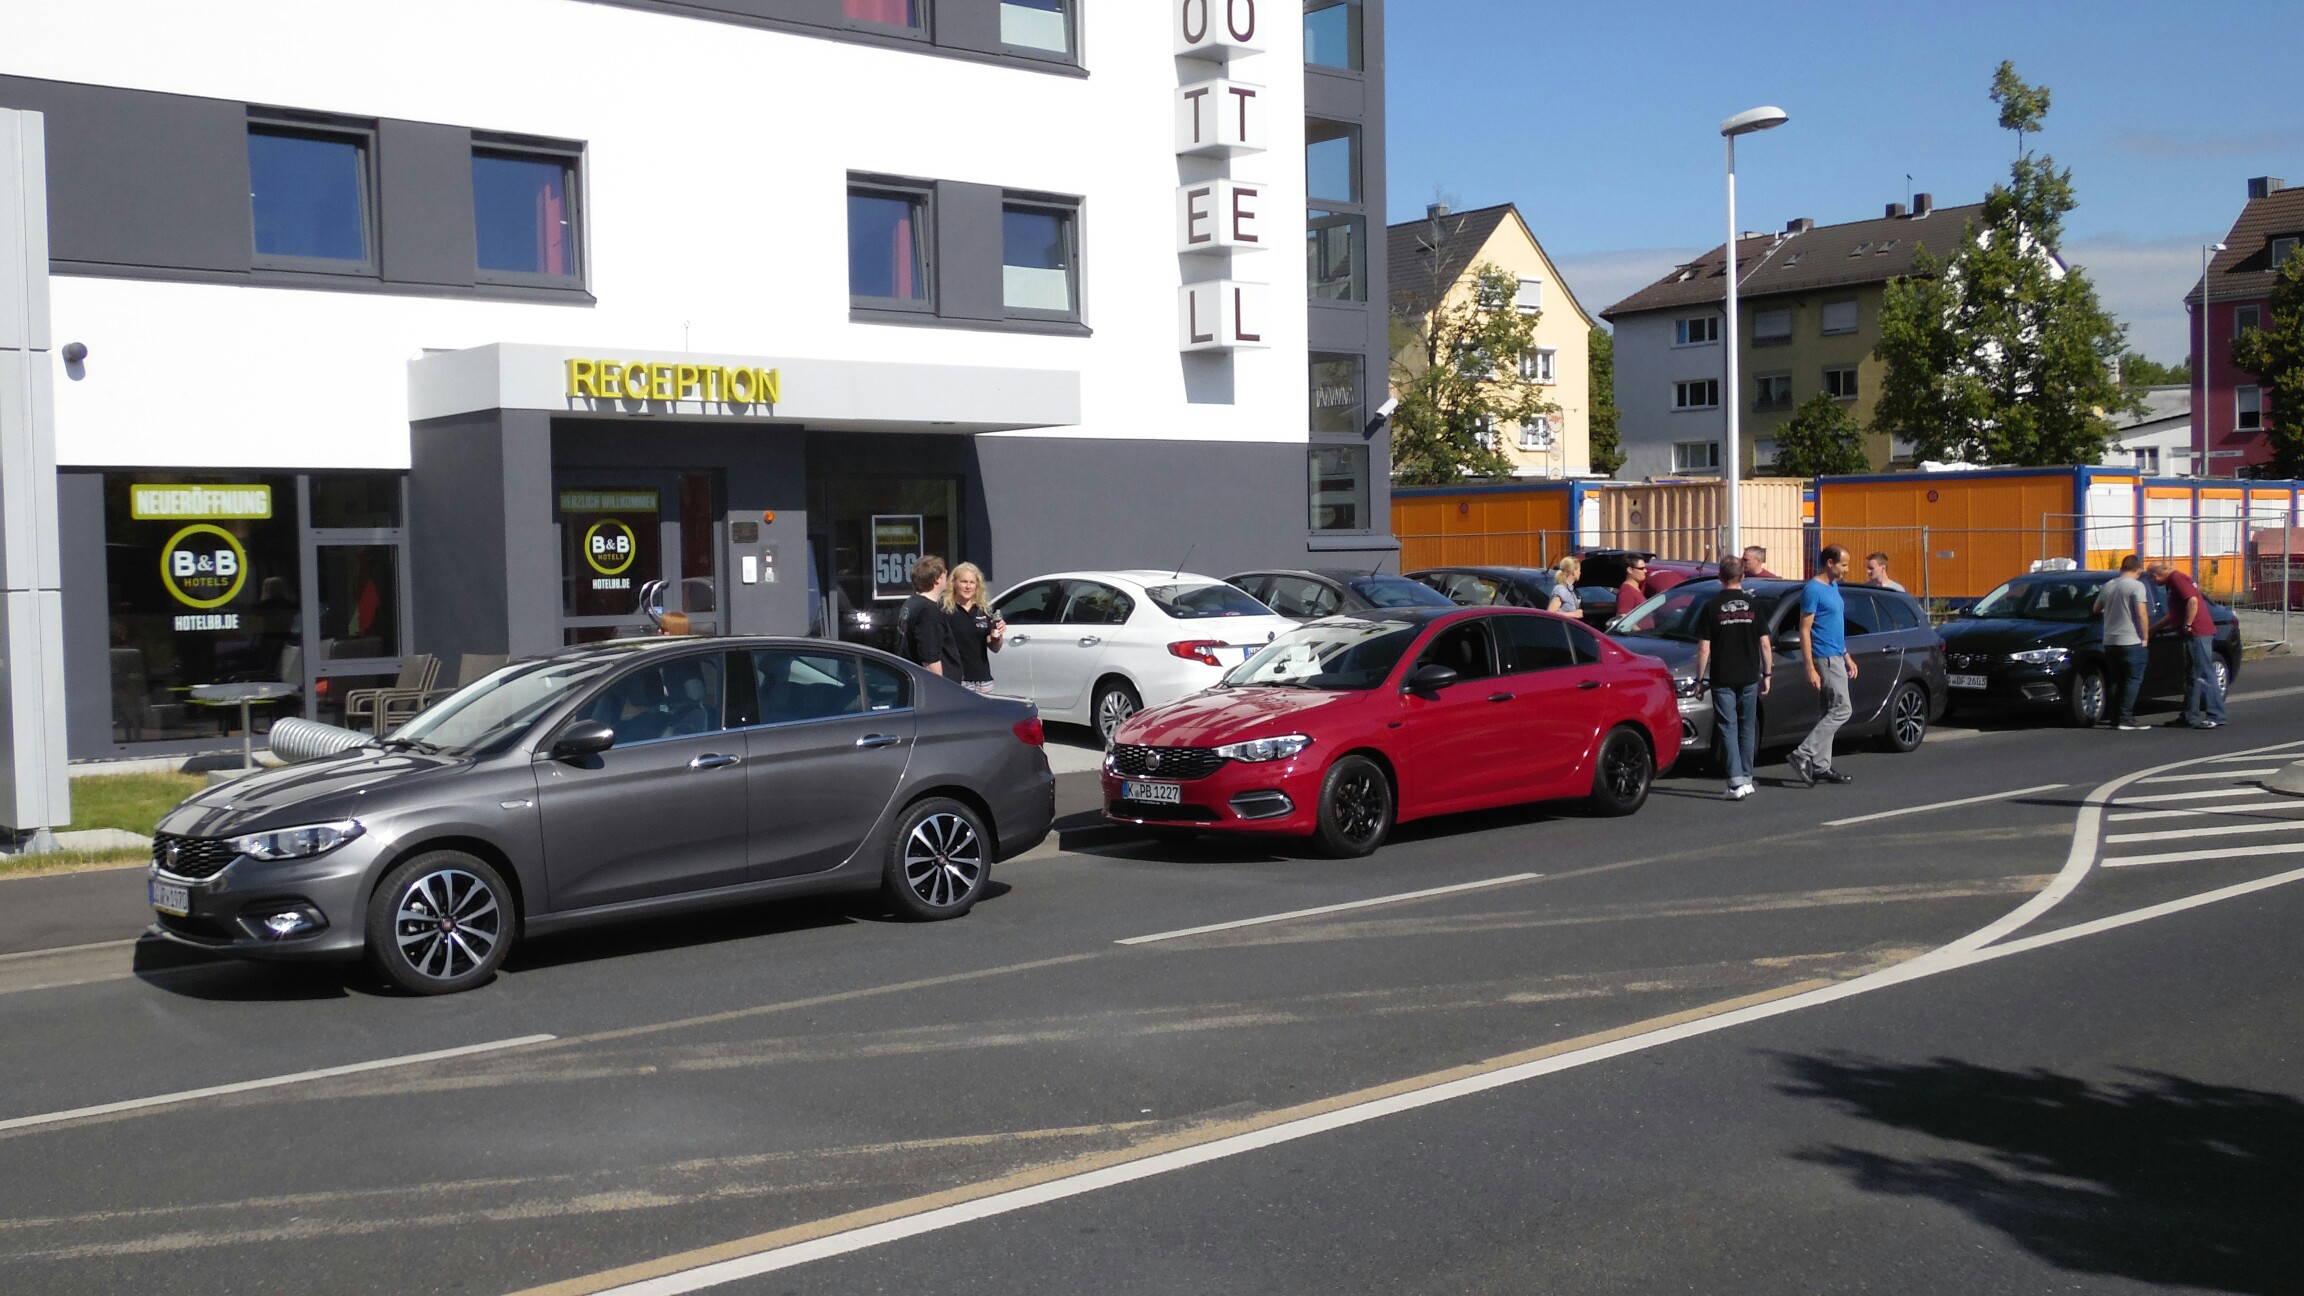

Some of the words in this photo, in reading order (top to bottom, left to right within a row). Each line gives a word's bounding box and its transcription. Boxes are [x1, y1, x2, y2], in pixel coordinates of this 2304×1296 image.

[566, 358, 780, 403] RECEPTION
[136, 487, 268, 514] NEUERÖFFNUNG
[592, 535, 630, 553] B&B
[173, 550, 237, 576] B&B
[184, 577, 228, 587] HOTELS
[592, 578, 631, 589] HOTELBB.DE
[174, 614, 240, 631] HOTELBB.DE
[1153, 785, 1179, 800] 1227
